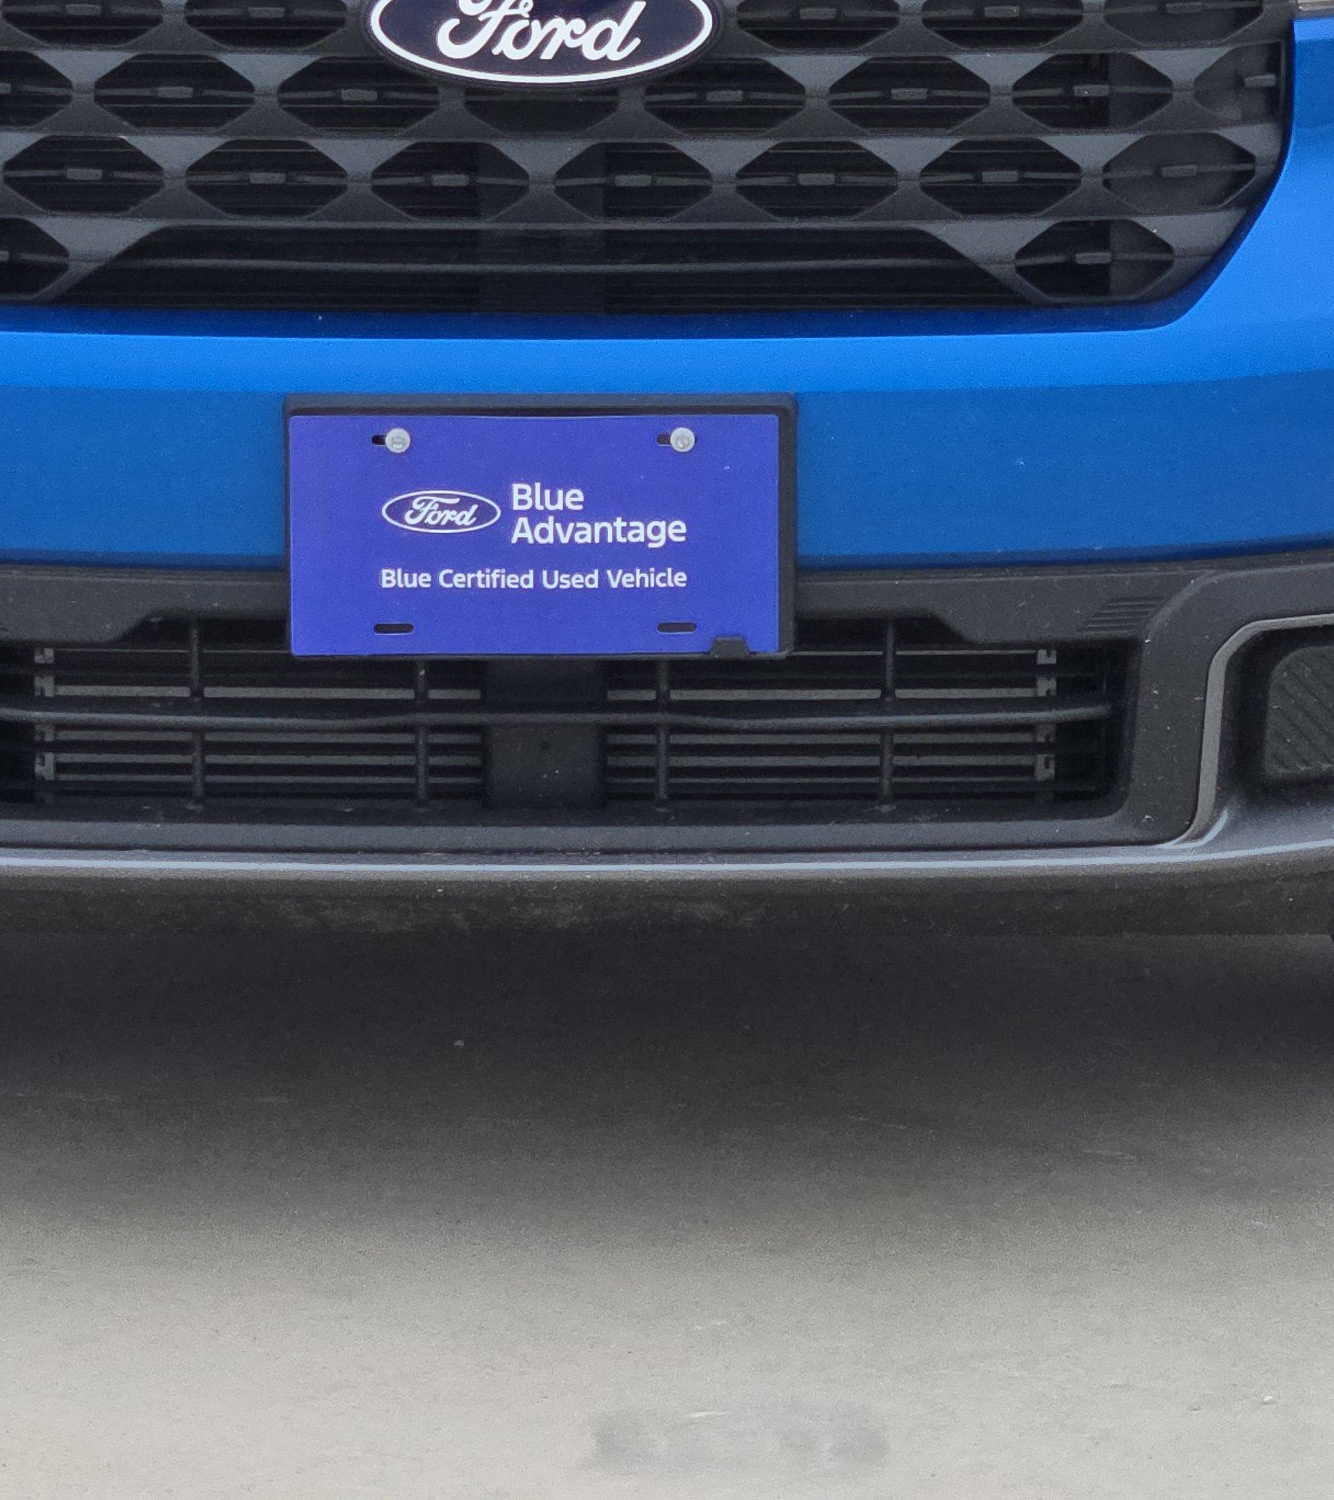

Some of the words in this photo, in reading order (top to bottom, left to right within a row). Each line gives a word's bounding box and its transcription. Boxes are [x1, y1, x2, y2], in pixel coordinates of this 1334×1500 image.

[404, 496, 478, 526] Ford
[511, 483, 585, 511] Blue
[510, 516, 687, 548] Advantage
[381, 568, 432, 589] Blue
[438, 568, 535, 589] Certified
[542, 568, 599, 589] Used
[606, 567, 687, 589] Vehicle
